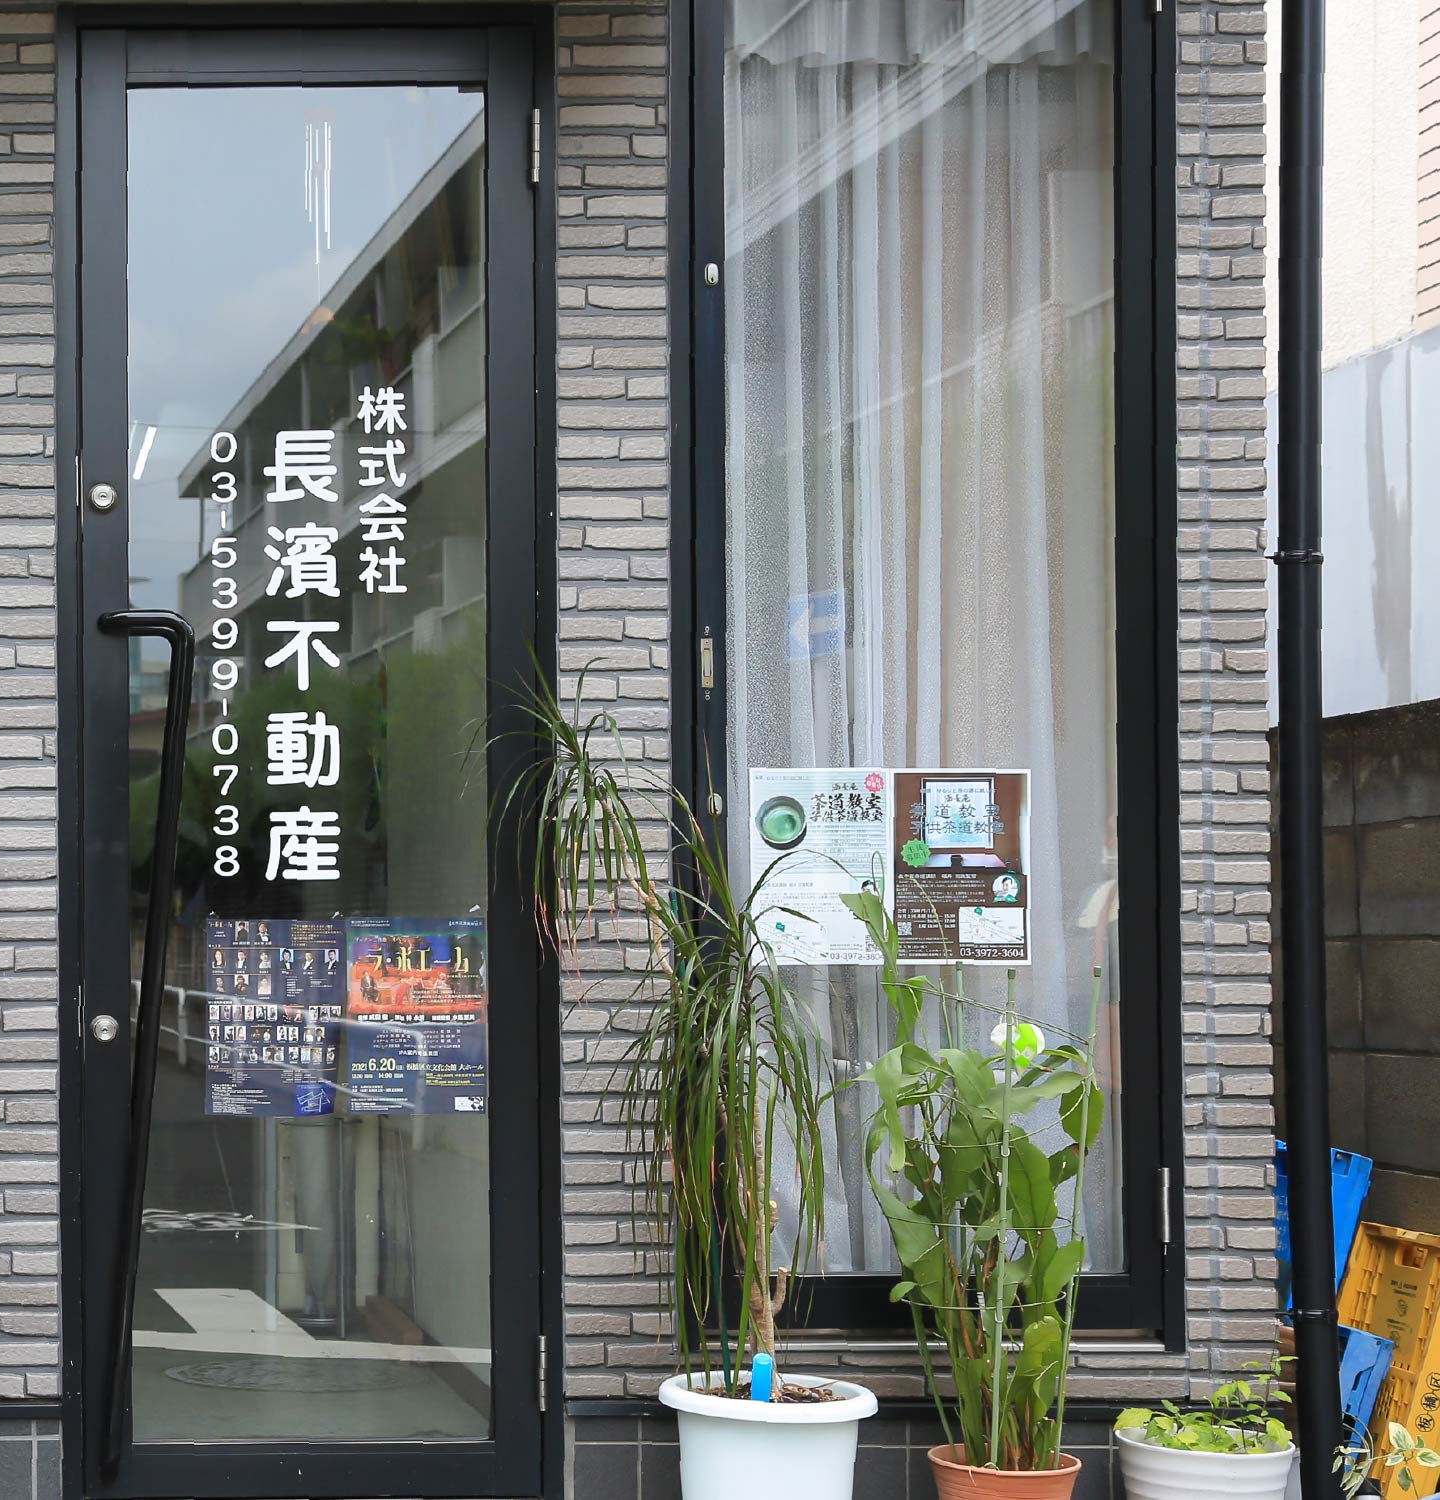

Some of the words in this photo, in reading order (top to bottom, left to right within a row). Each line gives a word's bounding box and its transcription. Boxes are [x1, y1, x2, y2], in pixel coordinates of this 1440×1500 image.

[357, 386, 407, 594] 株式会社
[210, 432, 240, 877] 03-5399-0738
[263, 430, 341, 881] 長濱不動産
[810, 793, 882, 811] 茶道教室
[809, 809, 884, 823] 子供茶道教室
[910, 803, 1001, 819] 茶道教室
[910, 820, 1005, 835] 子供茶道教室
[366, 945, 471, 973] ラ・ボエーム
[960, 948, 1025, 958] 03-3972-3604
[351, 1063, 368, 1071] 2021
[368, 1057, 396, 1071] 6.20
[458, 1063, 485, 1071] 大ホール
